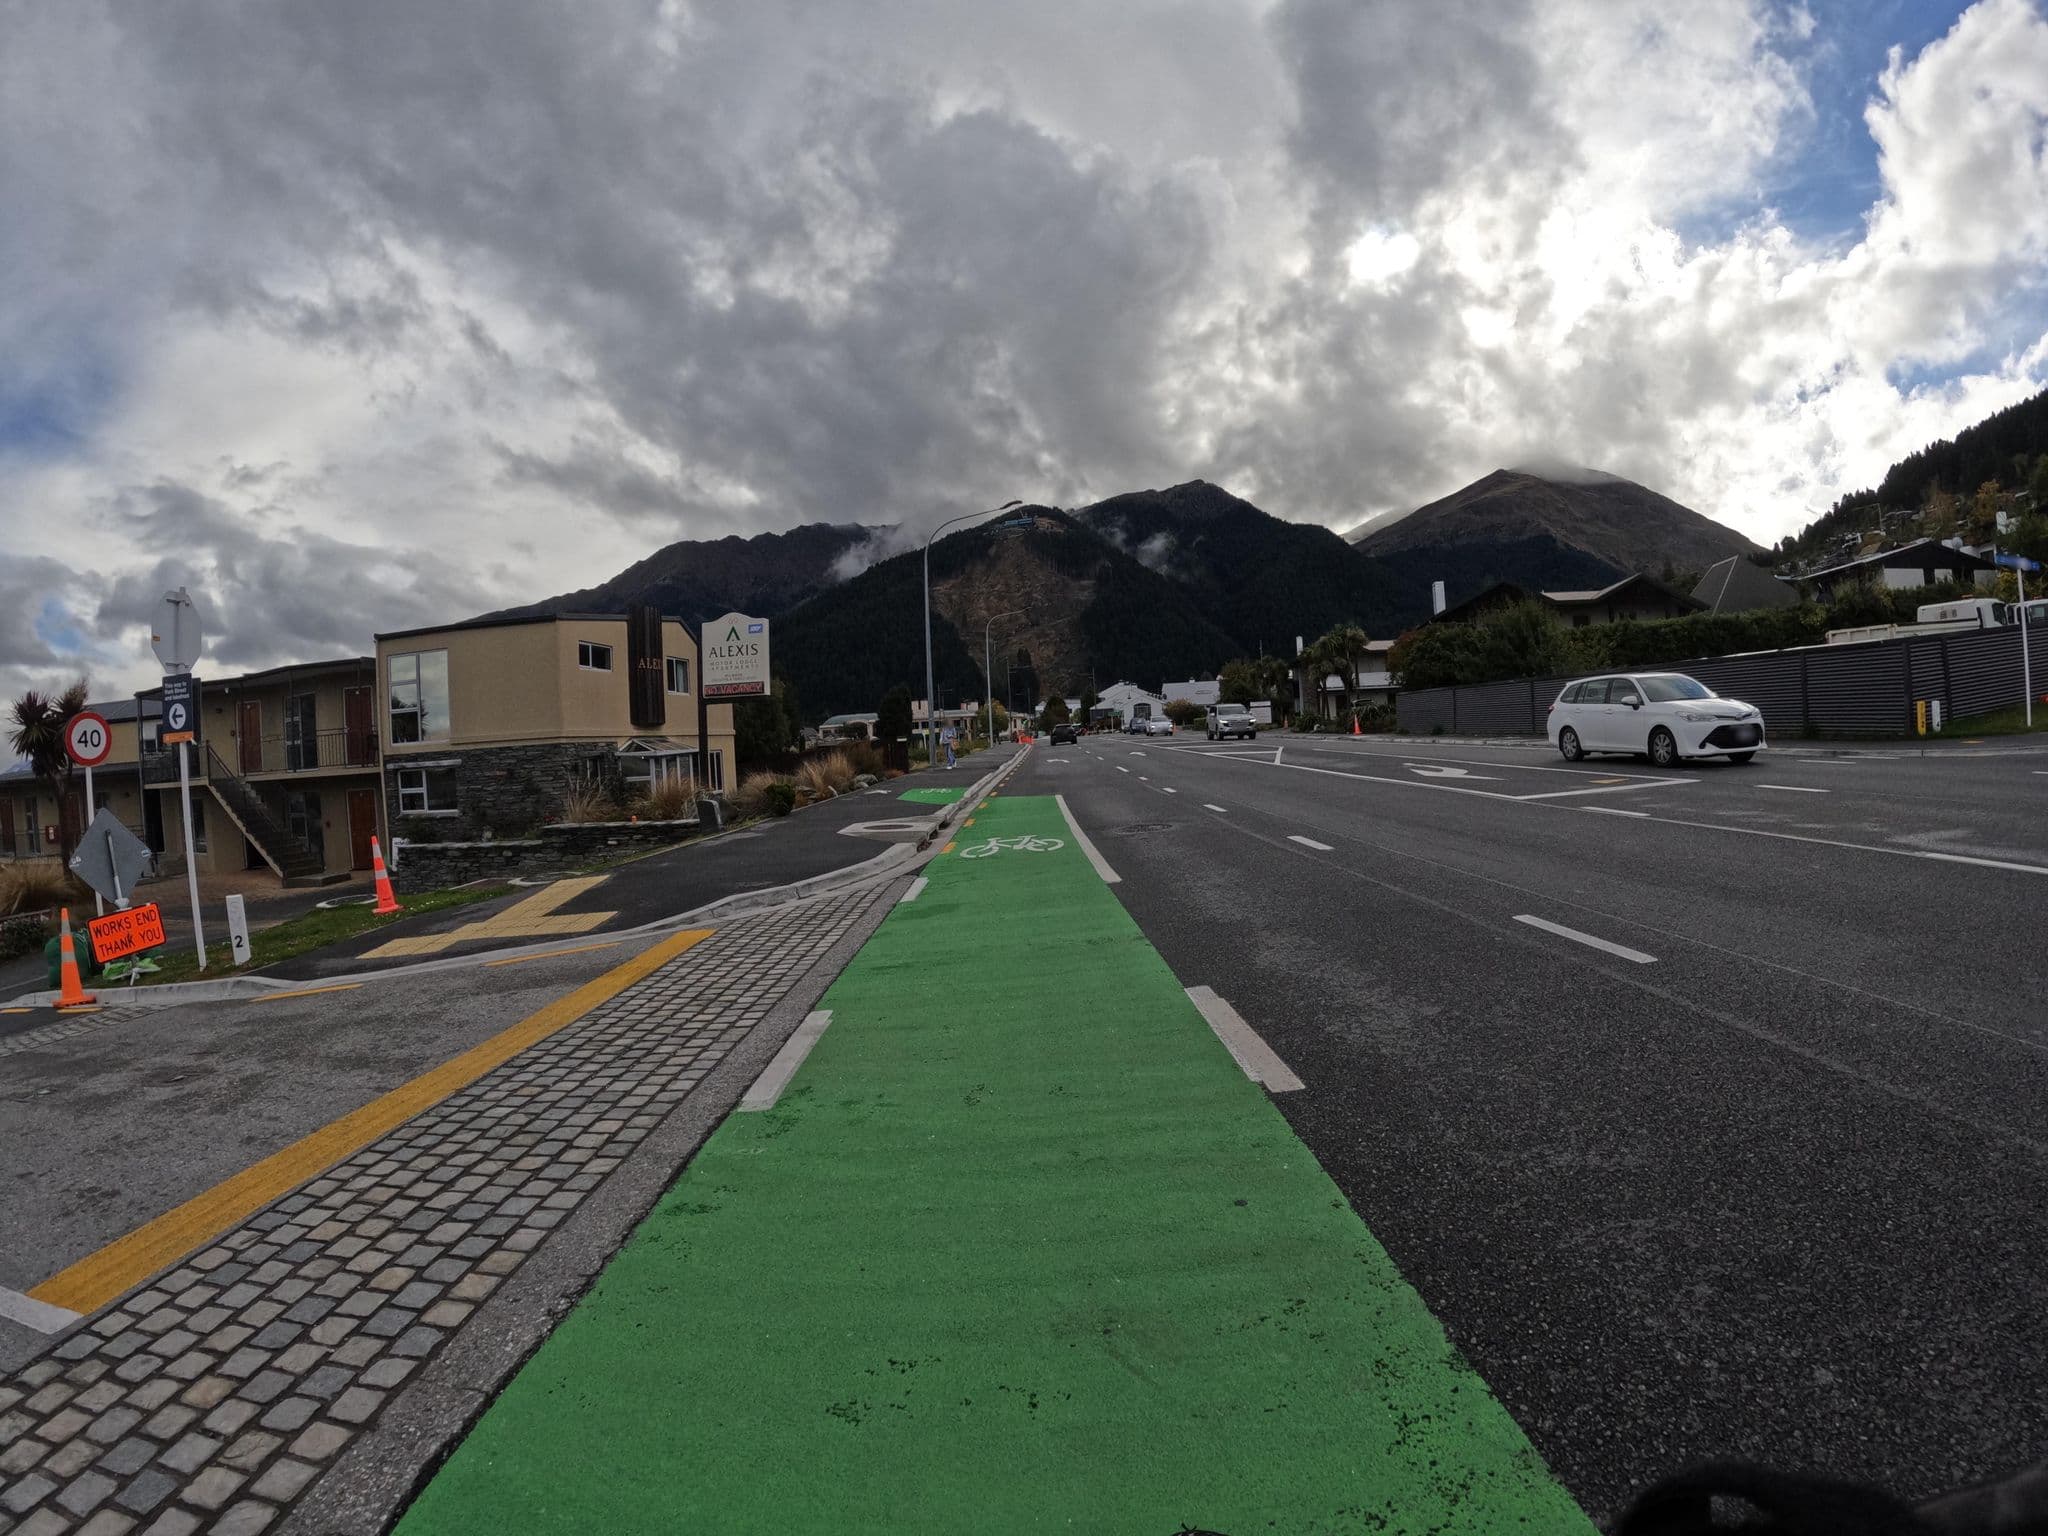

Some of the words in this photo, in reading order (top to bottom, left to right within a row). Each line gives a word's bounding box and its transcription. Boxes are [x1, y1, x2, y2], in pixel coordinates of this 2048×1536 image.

[708, 643, 759, 658] ALEXIS
[720, 682, 761, 695] VACANCY
[77, 729, 101, 748] 40
[93, 916, 132, 938] WORKS
[135, 909, 157, 926] END
[98, 934, 136, 957] THANK
[139, 927, 161, 944] YOU
[234, 935, 244, 948] 2
